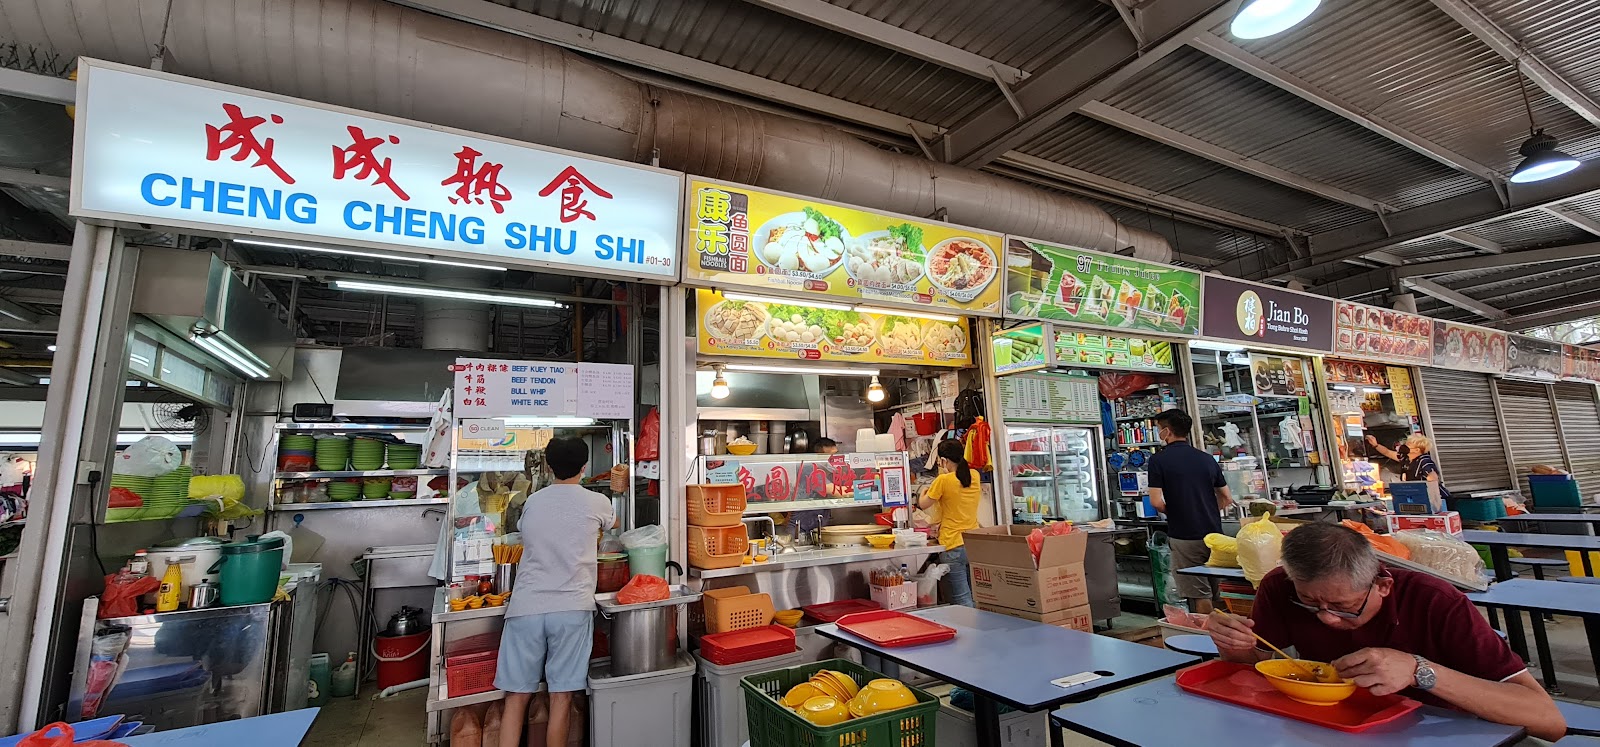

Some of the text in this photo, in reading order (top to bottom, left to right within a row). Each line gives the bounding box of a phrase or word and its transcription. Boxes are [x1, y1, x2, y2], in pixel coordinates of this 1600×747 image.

[205, 102, 614, 223] 成成熟食
[140, 172, 671, 267] CHENG CHENG SHU SHI #01-30
[696, 189, 731, 255] 康乐
[701, 260, 727, 268] NOODLES
[729, 212, 749, 274] 鱼圆面
[1077, 254, 1161, 281] 97 Fruits Juice
[1267, 300, 1309, 326] Jian Bo
[550, 366, 565, 374] TIAO
